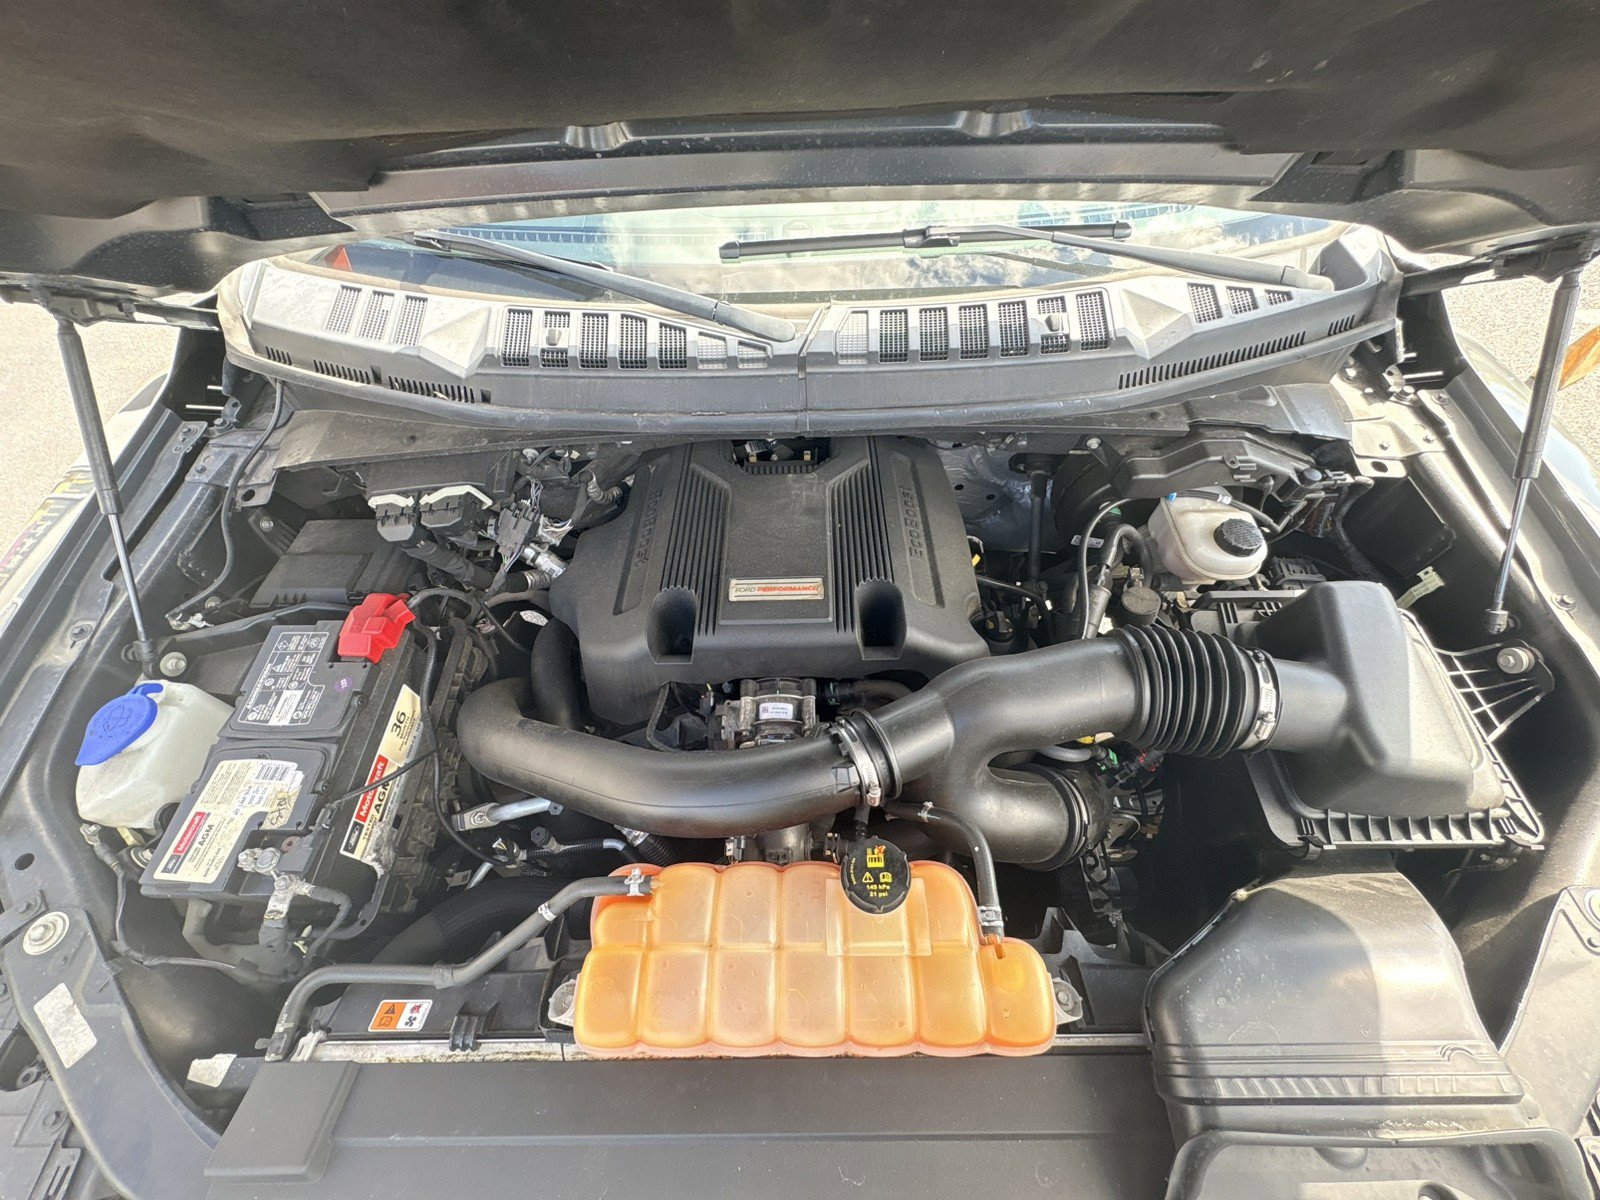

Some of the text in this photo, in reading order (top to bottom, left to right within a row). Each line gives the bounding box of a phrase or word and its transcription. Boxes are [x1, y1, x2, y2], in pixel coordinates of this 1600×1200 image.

[757, 585, 819, 593] PERFORMANCE
[391, 711, 407, 738] 36
[360, 761, 385, 817] Motoraft
[177, 814, 202, 852] Motorcraft
[199, 824, 215, 847] AGM
